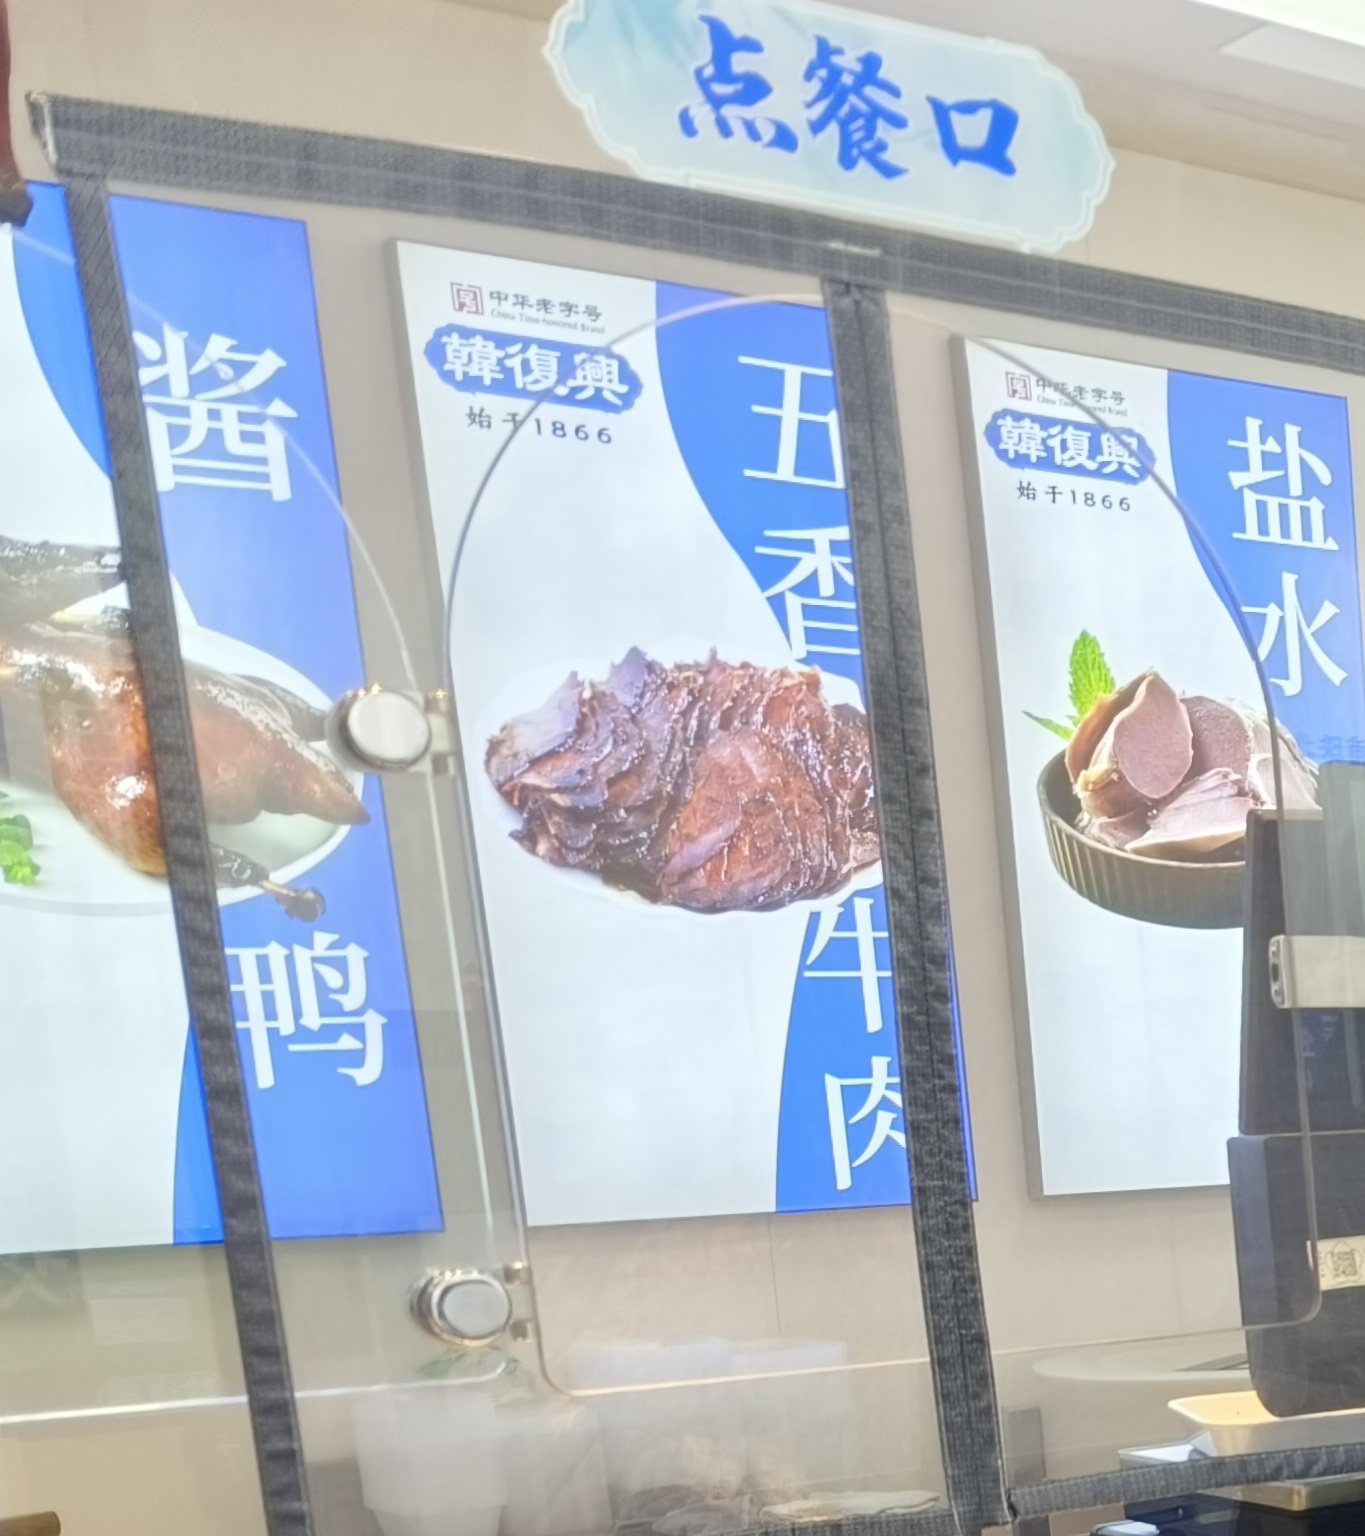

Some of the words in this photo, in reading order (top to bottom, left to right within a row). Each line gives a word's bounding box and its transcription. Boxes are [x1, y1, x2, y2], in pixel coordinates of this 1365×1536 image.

[679, 15, 1019, 180] 点餐口
[441, 332, 629, 406] 韓復興
[489, 290, 602, 322] 中华老字号
[133, 323, 298, 501] 酱
[997, 415, 1142, 479] 韓復興
[1016, 480, 1131, 512] 始于1866
[1226, 415, 1348, 696] 盐水
[225, 931, 388, 1089] 鸭
[803, 897, 906, 1190] 牛肉
